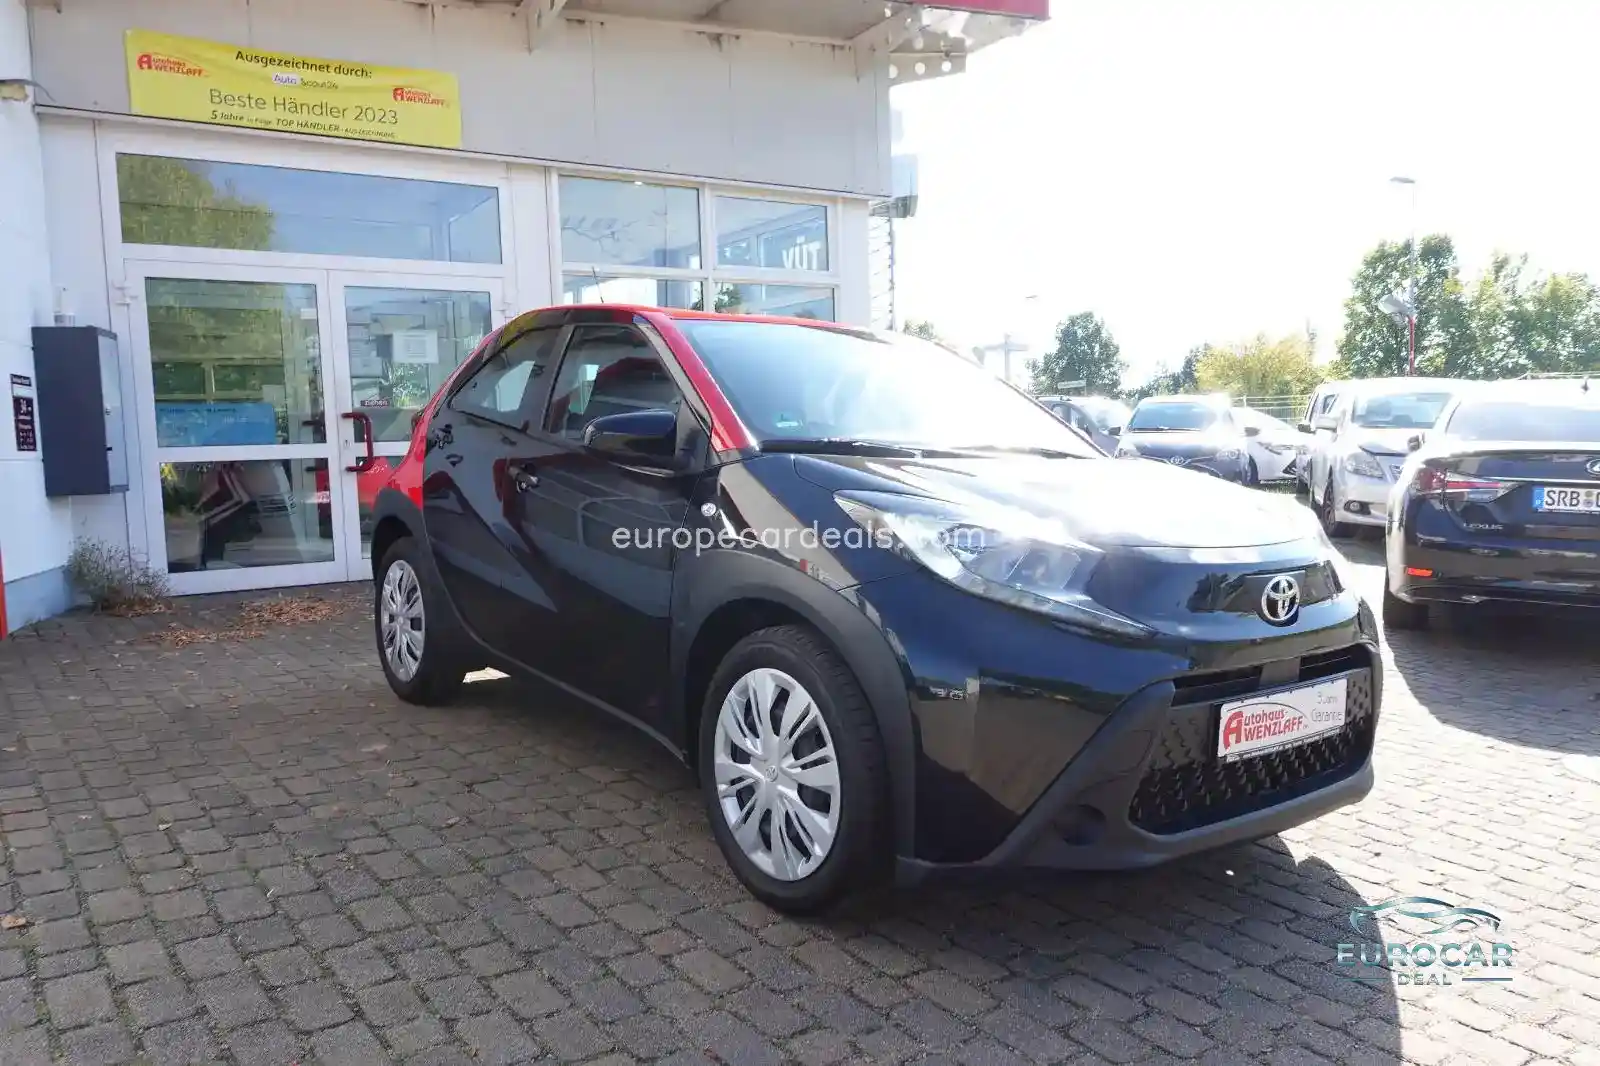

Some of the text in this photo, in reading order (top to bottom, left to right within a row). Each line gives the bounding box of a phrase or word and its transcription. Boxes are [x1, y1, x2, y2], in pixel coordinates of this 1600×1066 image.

[235, 50, 373, 79] Ausgezeichnet durch:
[209, 88, 399, 125] Beste Händler 2023
[210, 109, 218, 120] 5
[220, 111, 244, 122] Jahre
[276, 118, 295, 127] TOP
[1545, 489, 1581, 508] SRB
[1463, 522, 1504, 531] LEXUS
[1243, 715, 1304, 742] WENZLAFF
